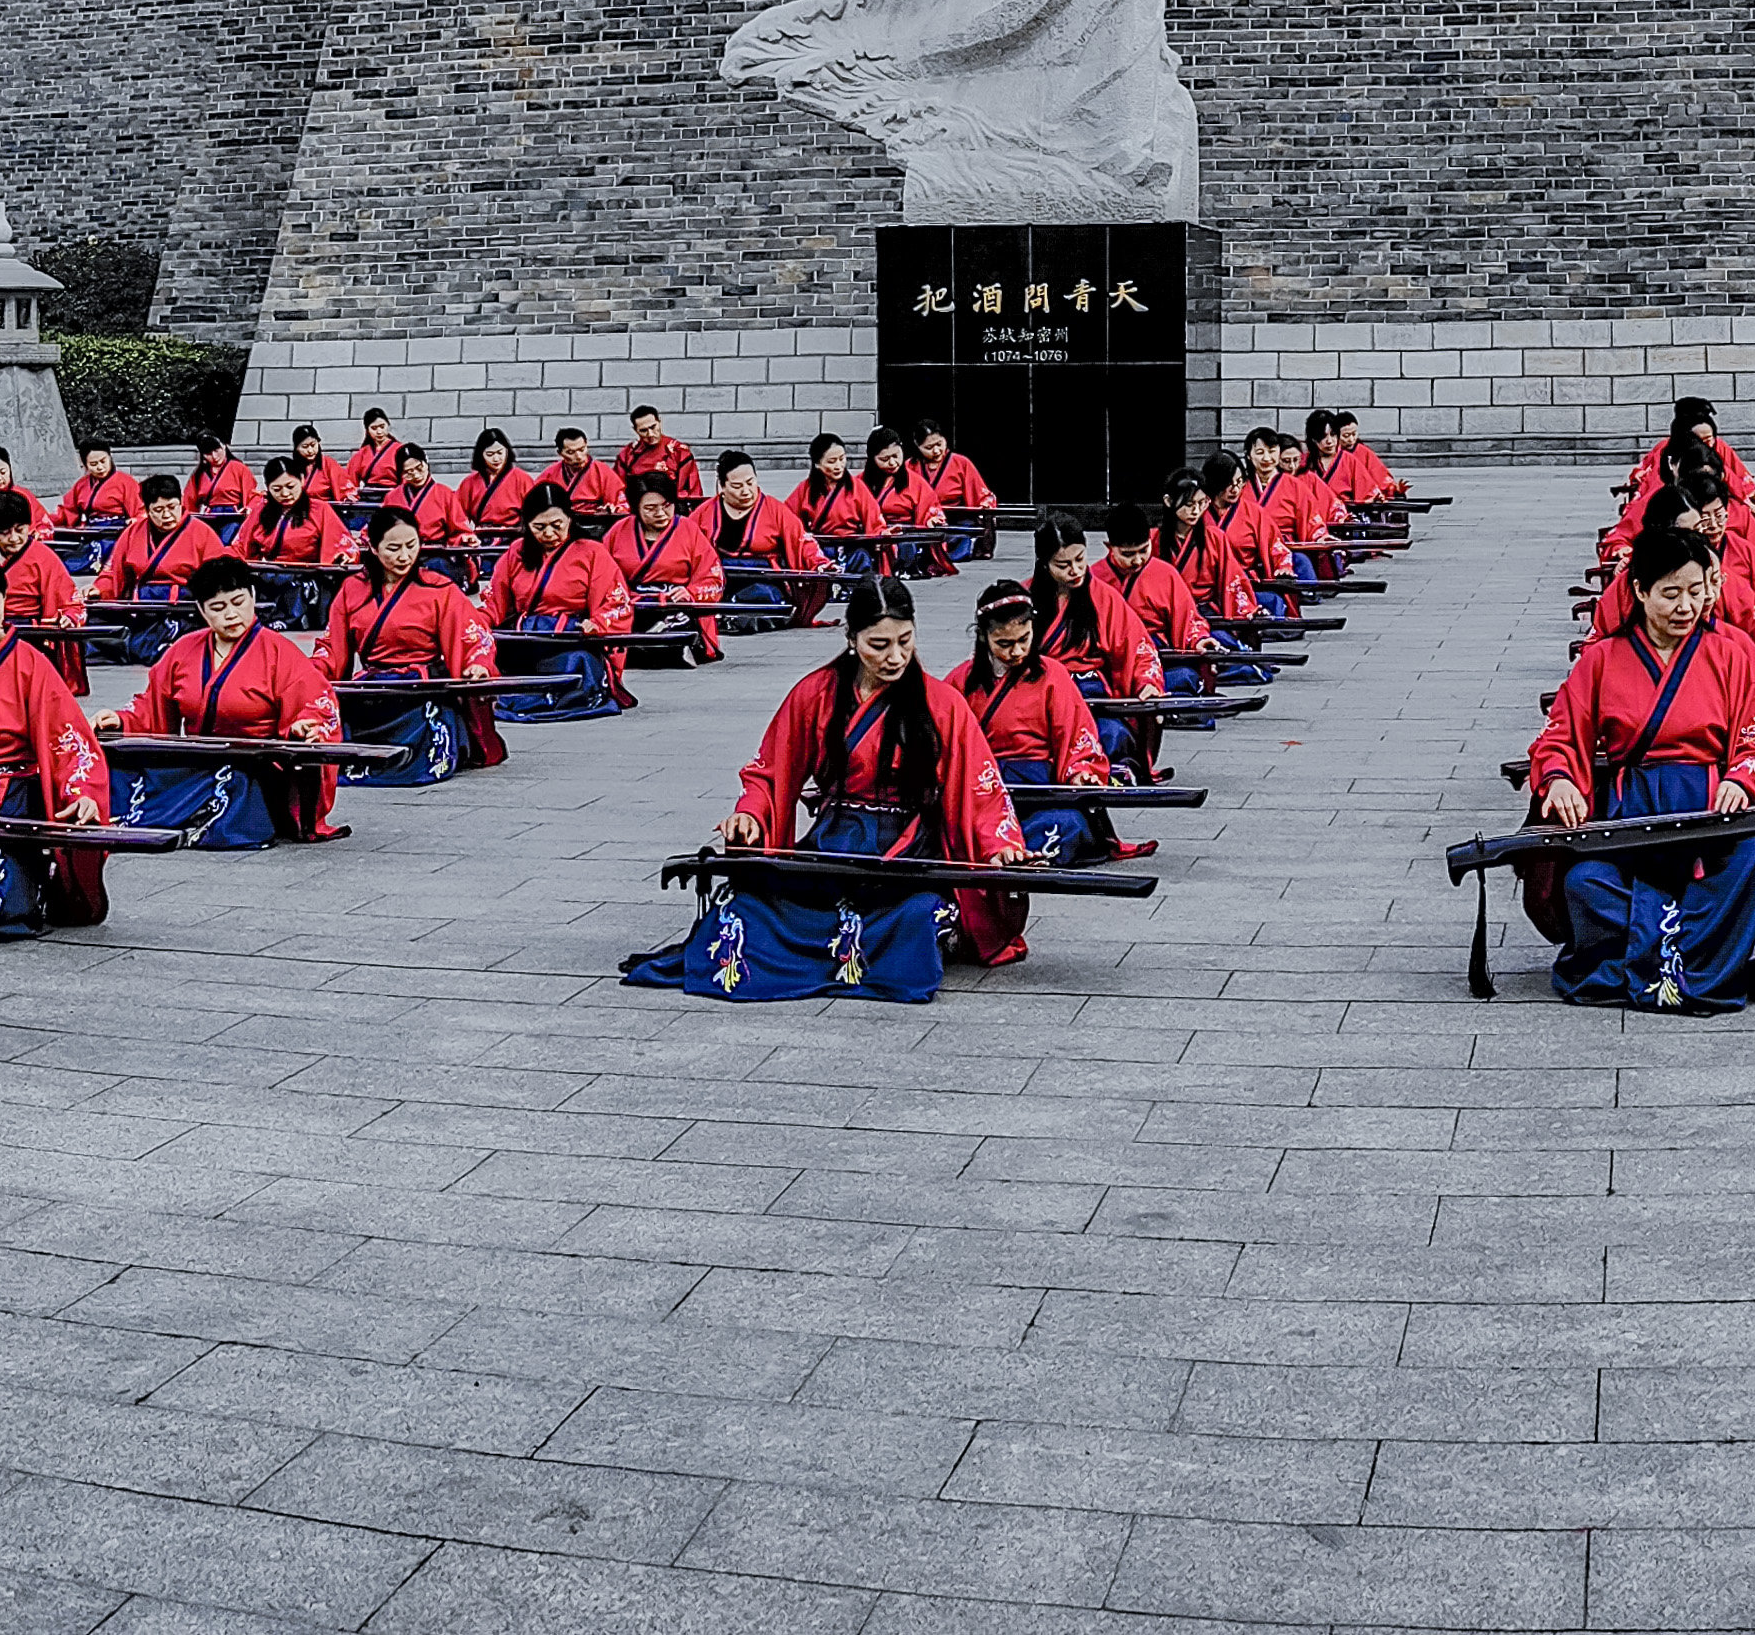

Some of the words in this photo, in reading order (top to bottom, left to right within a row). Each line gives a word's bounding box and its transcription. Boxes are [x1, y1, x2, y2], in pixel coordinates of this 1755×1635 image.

[913, 279, 1149, 317] 把酒問青天
